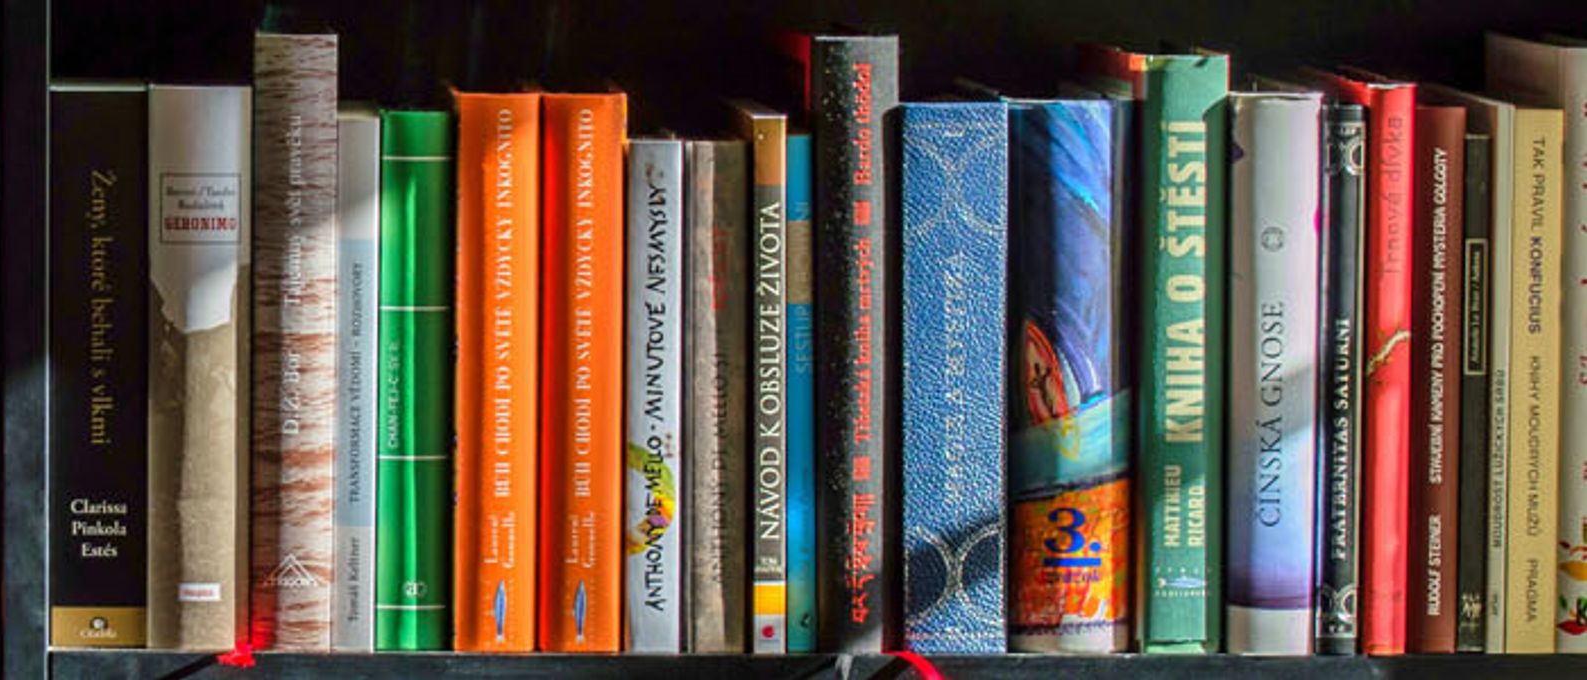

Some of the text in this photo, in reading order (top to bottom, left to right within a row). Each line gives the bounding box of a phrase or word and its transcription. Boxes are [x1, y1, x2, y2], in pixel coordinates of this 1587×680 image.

[495, 108, 514, 208] INKOGNITO
[575, 108, 594, 208] INKOGNITO
[1532, 137, 1545, 169] TAK
[164, 217, 237, 230] GERONIMO
[287, 190, 301, 226] svět
[1531, 174, 1545, 229] PRAVIL
[494, 217, 513, 300] VŽDYCKY
[573, 217, 593, 300] VŽDYCKY
[755, 201, 781, 296] ŽIVOTA
[852, 63, 873, 445] Tibetská kniha mrtvých Bardo thödol
[84, 170, 118, 445] Ženy, ktoré behali s vlkmi
[351, 263, 363, 338] ROZHOVORY
[1159, 120, 1205, 442] KNIHA O ŠTĚSTÍ
[1528, 236, 1542, 335] KONFUCIUS
[493, 307, 513, 360] SVĚTĚ
[573, 307, 592, 360] SVĚTĚ
[759, 304, 781, 415] OBSLUZE
[794, 307, 812, 373] SESTUP
[284, 350, 299, 384] Bor
[346, 350, 362, 401] VĚDOMÍ
[495, 366, 512, 390] PO
[574, 366, 592, 390] PO
[641, 183, 667, 612] ANTHONY DE MELLO MINUTOVÉ NESMYSLY
[1426, 148, 1448, 616] RUDOLF STEINER STAVEBNÍ KAMENY PRO POCHOPENÍ MYSTERIA GOLGOTY
[1527, 356, 1541, 402] KNIHY
[282, 415, 299, 435] D.
[493, 397, 512, 456] CHODÍ
[573, 397, 592, 456] CHODÍ
[711, 375, 729, 439] MELLO
[760, 420, 781, 437] K
[1252, 302, 1285, 527] ČÍNSKÁ GNOSE
[1331, 316, 1352, 562] FRATERNITAS SATURNI
[348, 405, 362, 503] TRANSFORMACE
[1526, 406, 1542, 490] MOUDRÝCH
[70, 498, 128, 515] Clarissa
[755, 446, 781, 540] NÁVOD
[1162, 465, 1182, 547] MATTHIEU
[1186, 484, 1205, 547] RICARD
[1492, 478, 1503, 548] MOUDROST
[71, 520, 127, 537] Pinkola
[81, 542, 118, 557] Estés
[710, 482, 728, 584] ANTHONY
[1044, 507, 1102, 554] 3.
[346, 585, 360, 622] Tomáš
[1525, 559, 1538, 622] PRAGMA
